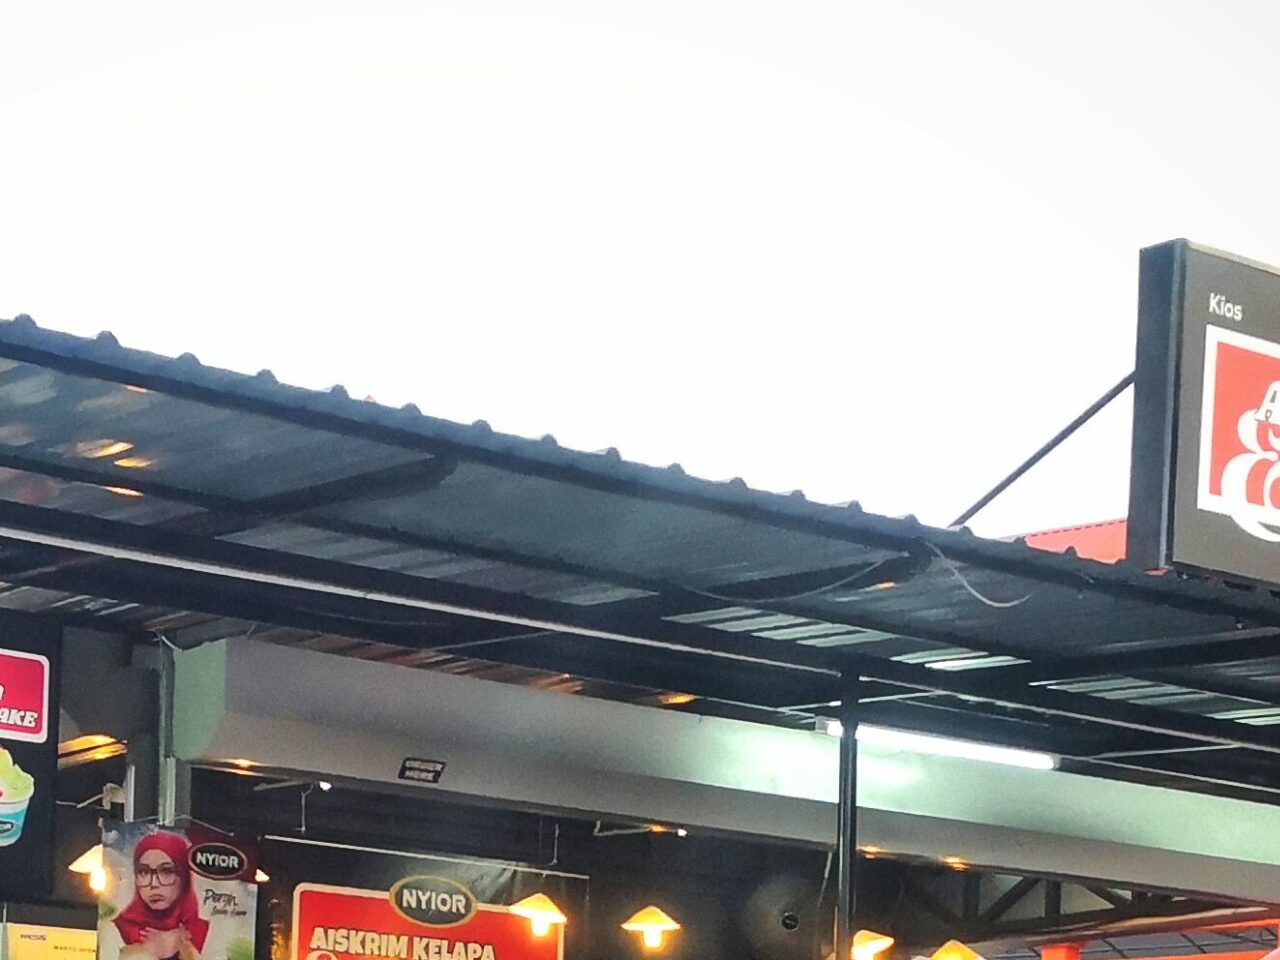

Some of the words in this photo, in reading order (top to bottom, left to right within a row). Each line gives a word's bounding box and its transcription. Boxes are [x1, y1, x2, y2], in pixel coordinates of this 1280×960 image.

[1208, 292, 1243, 322] Kios
[196, 851, 239, 869] NYIOR
[402, 888, 466, 914] NYIOR
[310, 927, 409, 960] AISKRIM
